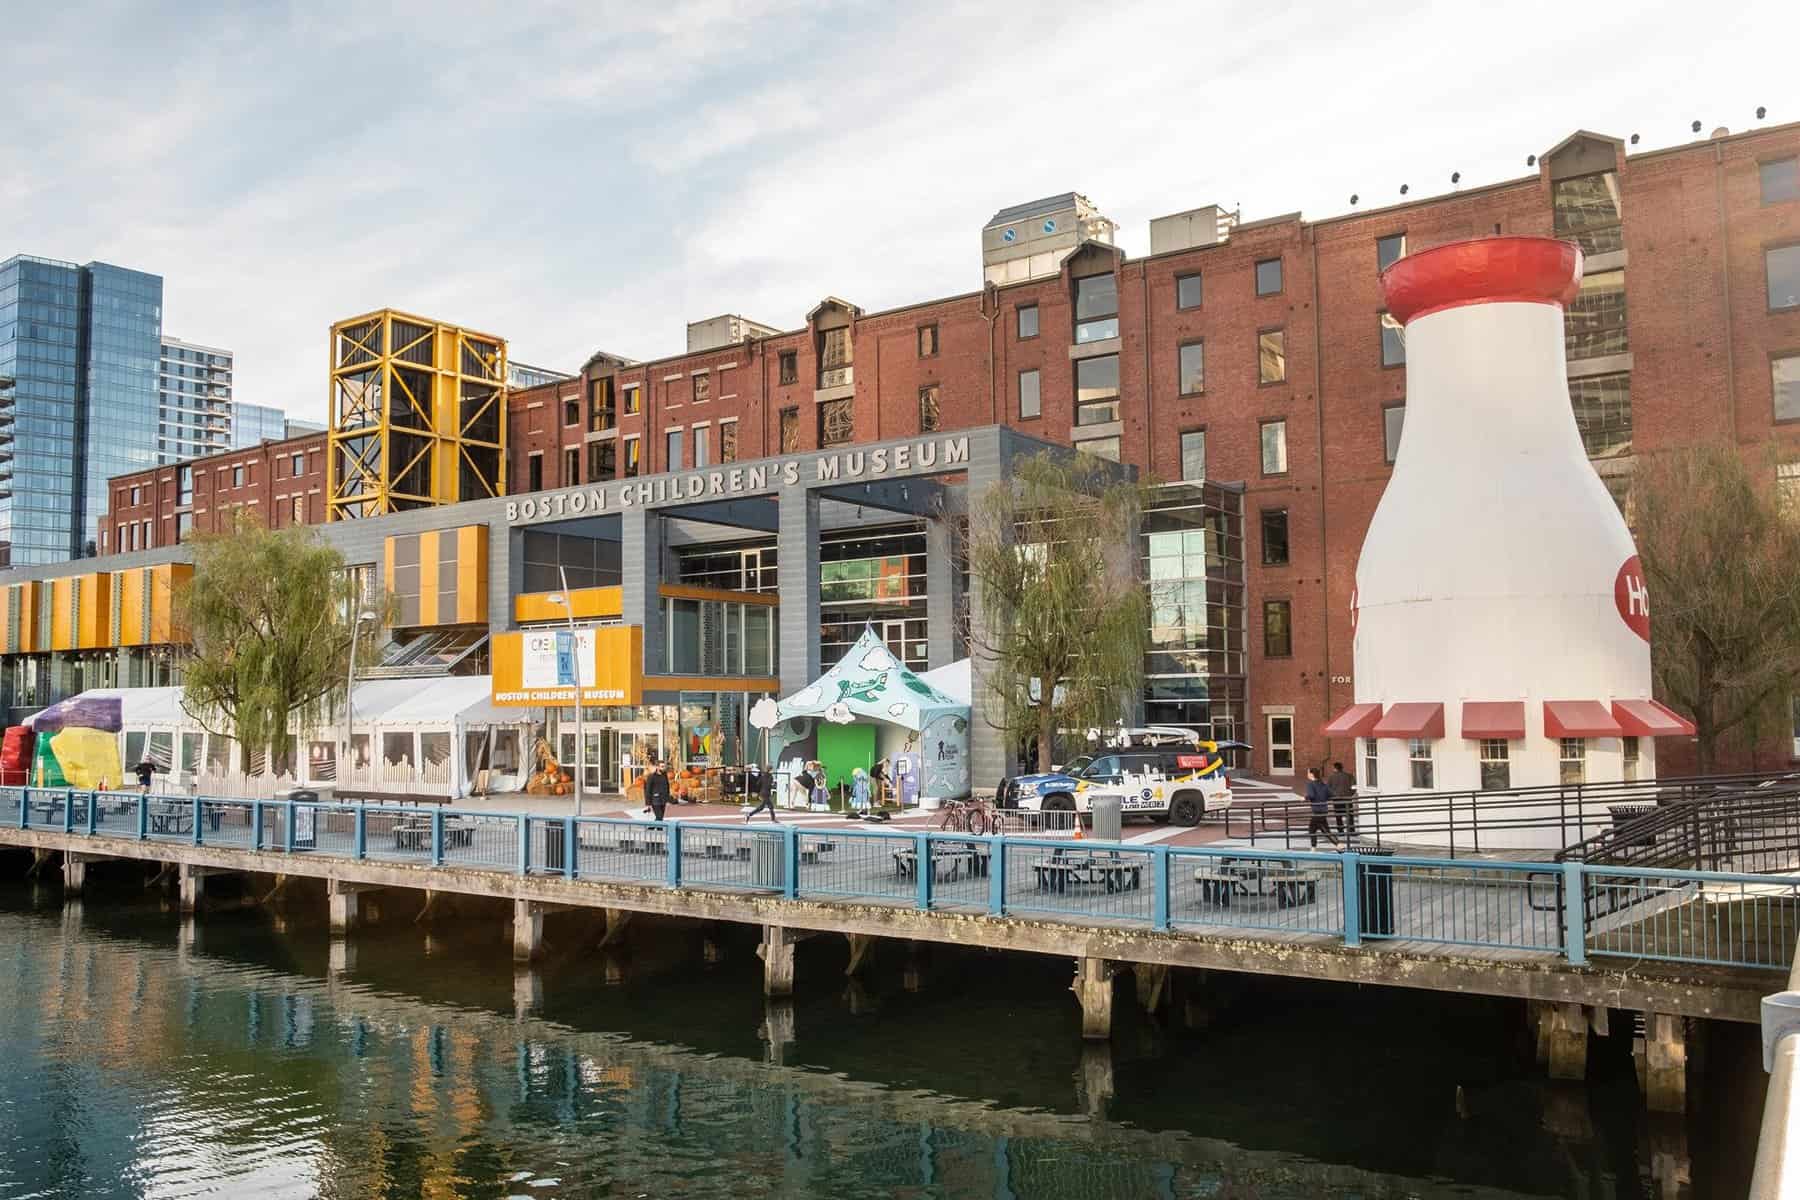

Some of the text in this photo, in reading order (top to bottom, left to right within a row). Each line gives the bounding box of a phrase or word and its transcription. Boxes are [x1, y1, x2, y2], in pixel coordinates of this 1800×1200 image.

[506, 437, 969, 521] BOSTON CHILDREN'S MUSEUM
[496, 690, 624, 701] BOSTON CHILDREN MUSEUM
